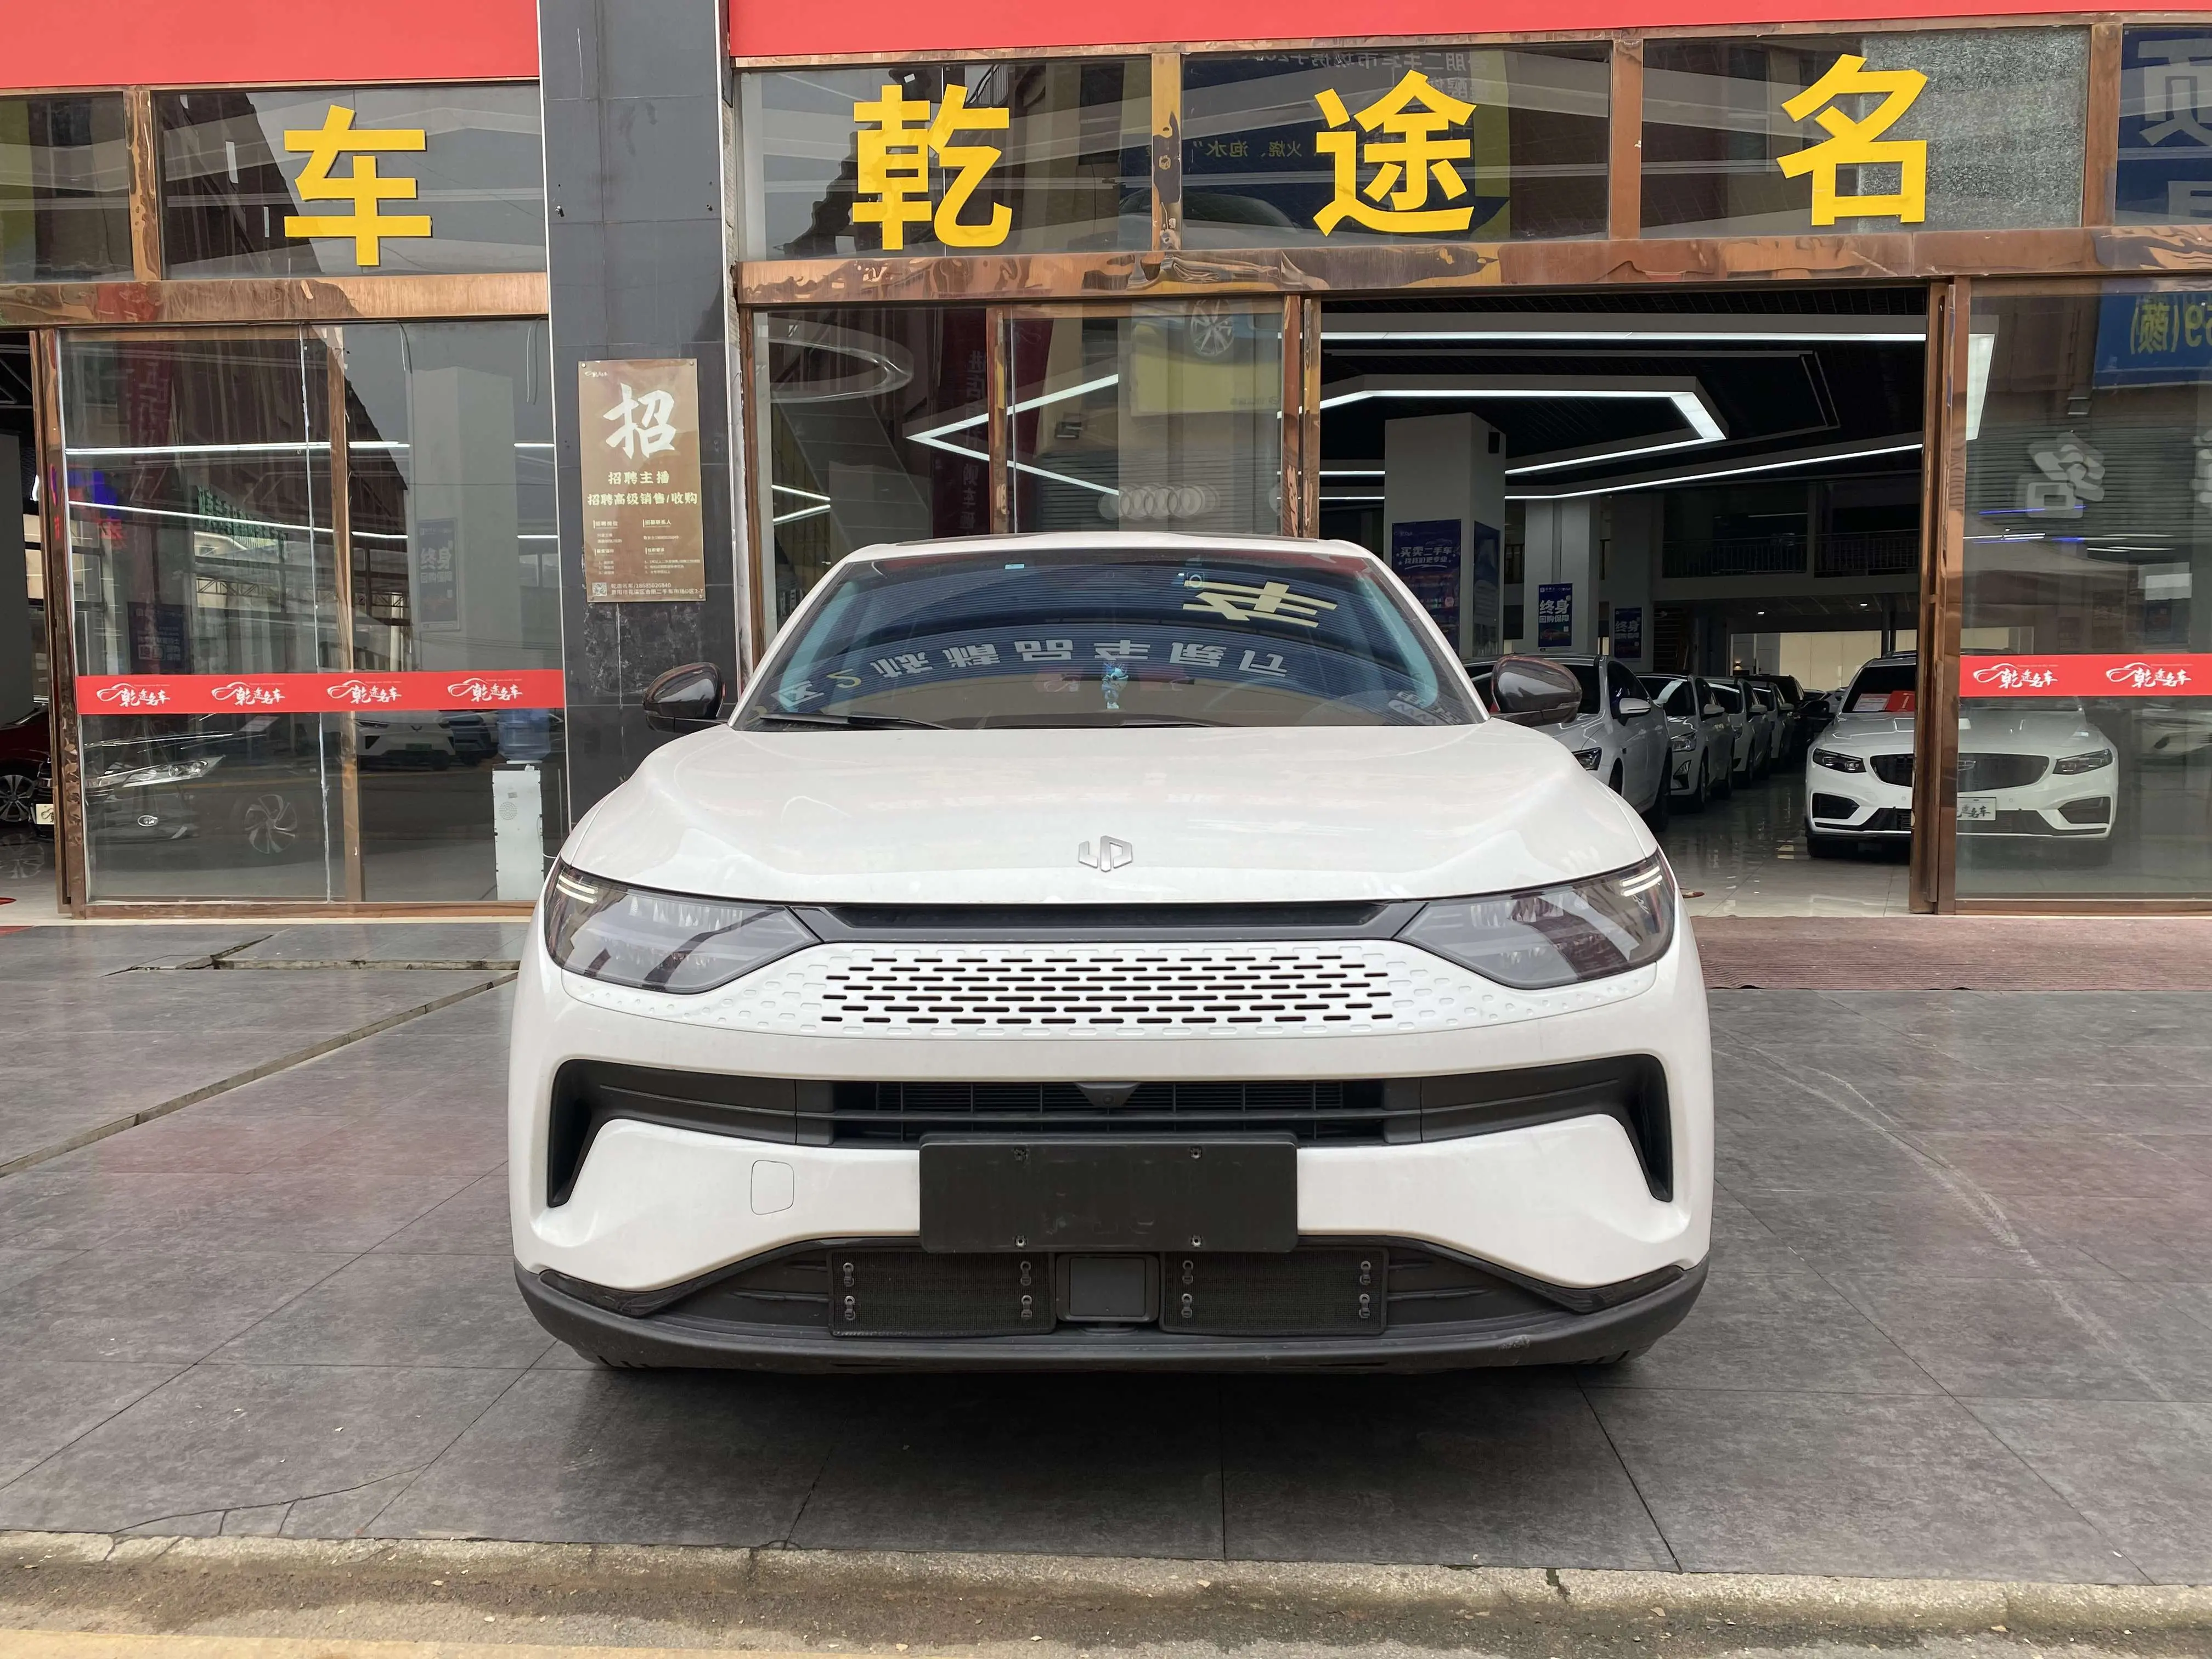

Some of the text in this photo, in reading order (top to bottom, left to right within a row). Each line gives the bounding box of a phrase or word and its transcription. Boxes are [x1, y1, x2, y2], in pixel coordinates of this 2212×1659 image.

[852, 84, 1013, 251] 乾
[1313, 69, 1477, 237] 途
[1776, 53, 1928, 227] 名
[283, 104, 432, 267] 车
[603, 382, 677, 460] 招
[608, 470, 670, 486] 招聘主播
[586, 491, 698, 506] 招聘高级销售/收购
[1400, 546, 1453, 558] 买卖二手车
[1539, 599, 1570, 615] 终身
[1615, 620, 1640, 632] 终身
